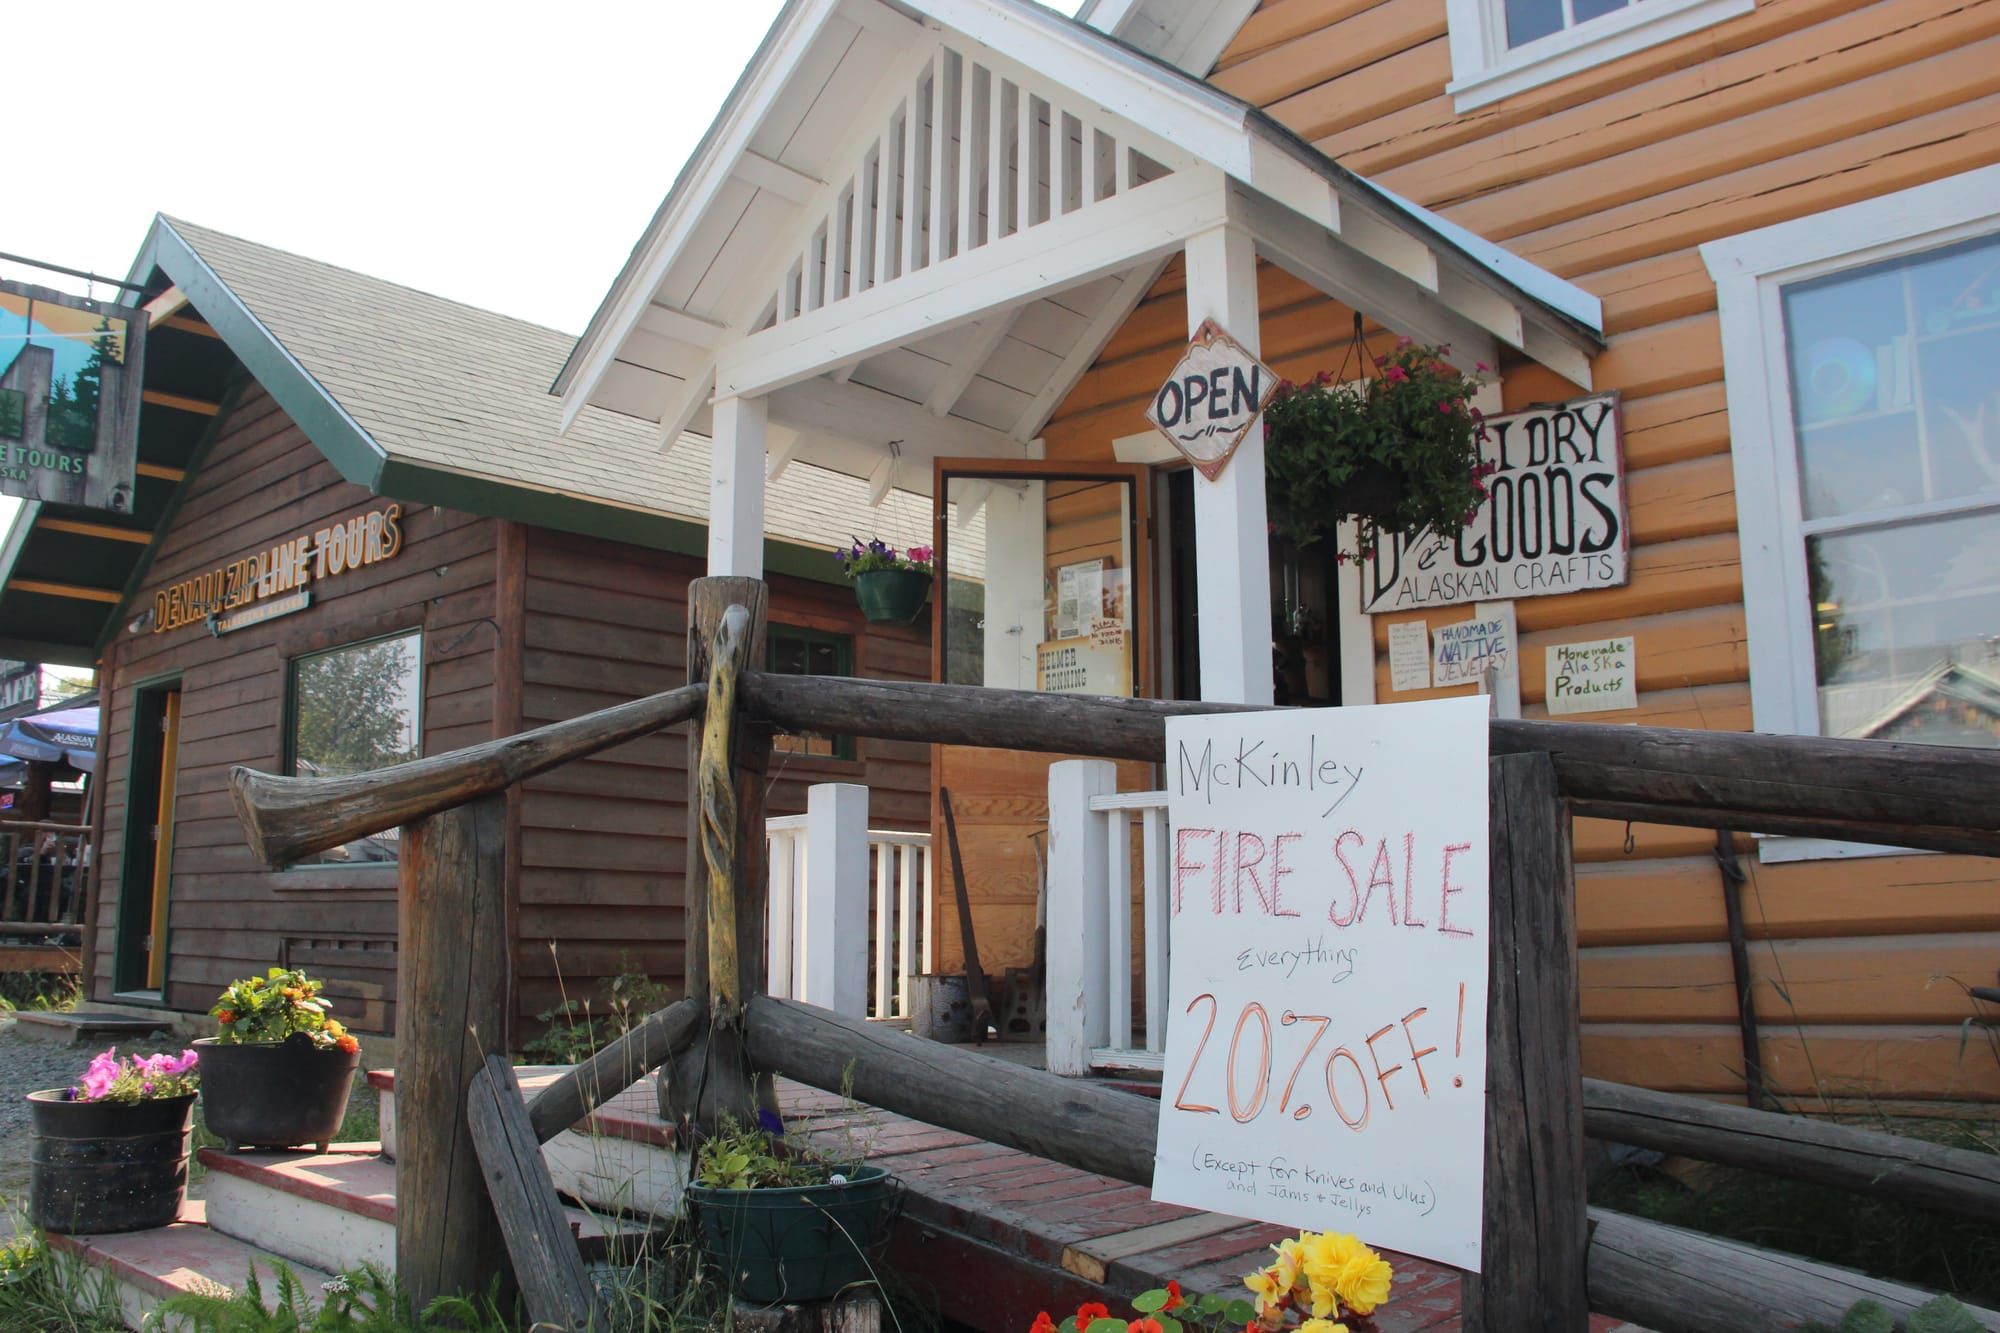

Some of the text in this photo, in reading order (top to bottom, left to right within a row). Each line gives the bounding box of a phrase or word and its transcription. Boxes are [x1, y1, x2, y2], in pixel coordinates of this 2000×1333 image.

[1157, 365, 1259, 428] OPEN
[1524, 402, 1613, 468] DRY
[0, 466, 27, 480] SKA
[16, 448, 83, 474] TOURS
[1454, 466, 1619, 568] GOODS
[154, 503, 402, 634] DENALI ZIPLINE TOURS
[1396, 566, 1499, 606] ALASKAN
[1513, 553, 1615, 590] CRAFTS
[1438, 636, 1507, 662] NATIVE
[1442, 620, 1503, 641] HANDMADE
[1039, 648, 1077, 671] HELMER
[1438, 651, 1509, 681] JEWELRY
[1557, 641, 1625, 660] Homemade
[0, 672, 38, 709] AFE
[1045, 667, 1087, 691] RONNING
[1555, 676, 1623, 697] Products
[1179, 735, 1363, 818] McKinley
[1172, 827, 1474, 938] FIRE SALE
[1174, 993, 1331, 1125] 20%
[1192, 1144, 1260, 1179] (Except
[1267, 1156, 1298, 1180] for
[1359, 1180, 1386, 1200] and
[1226, 1179, 1257, 1194] and
[1267, 1184, 1309, 1202] Jams
[1330, 1193, 1372, 1218] Jellys
